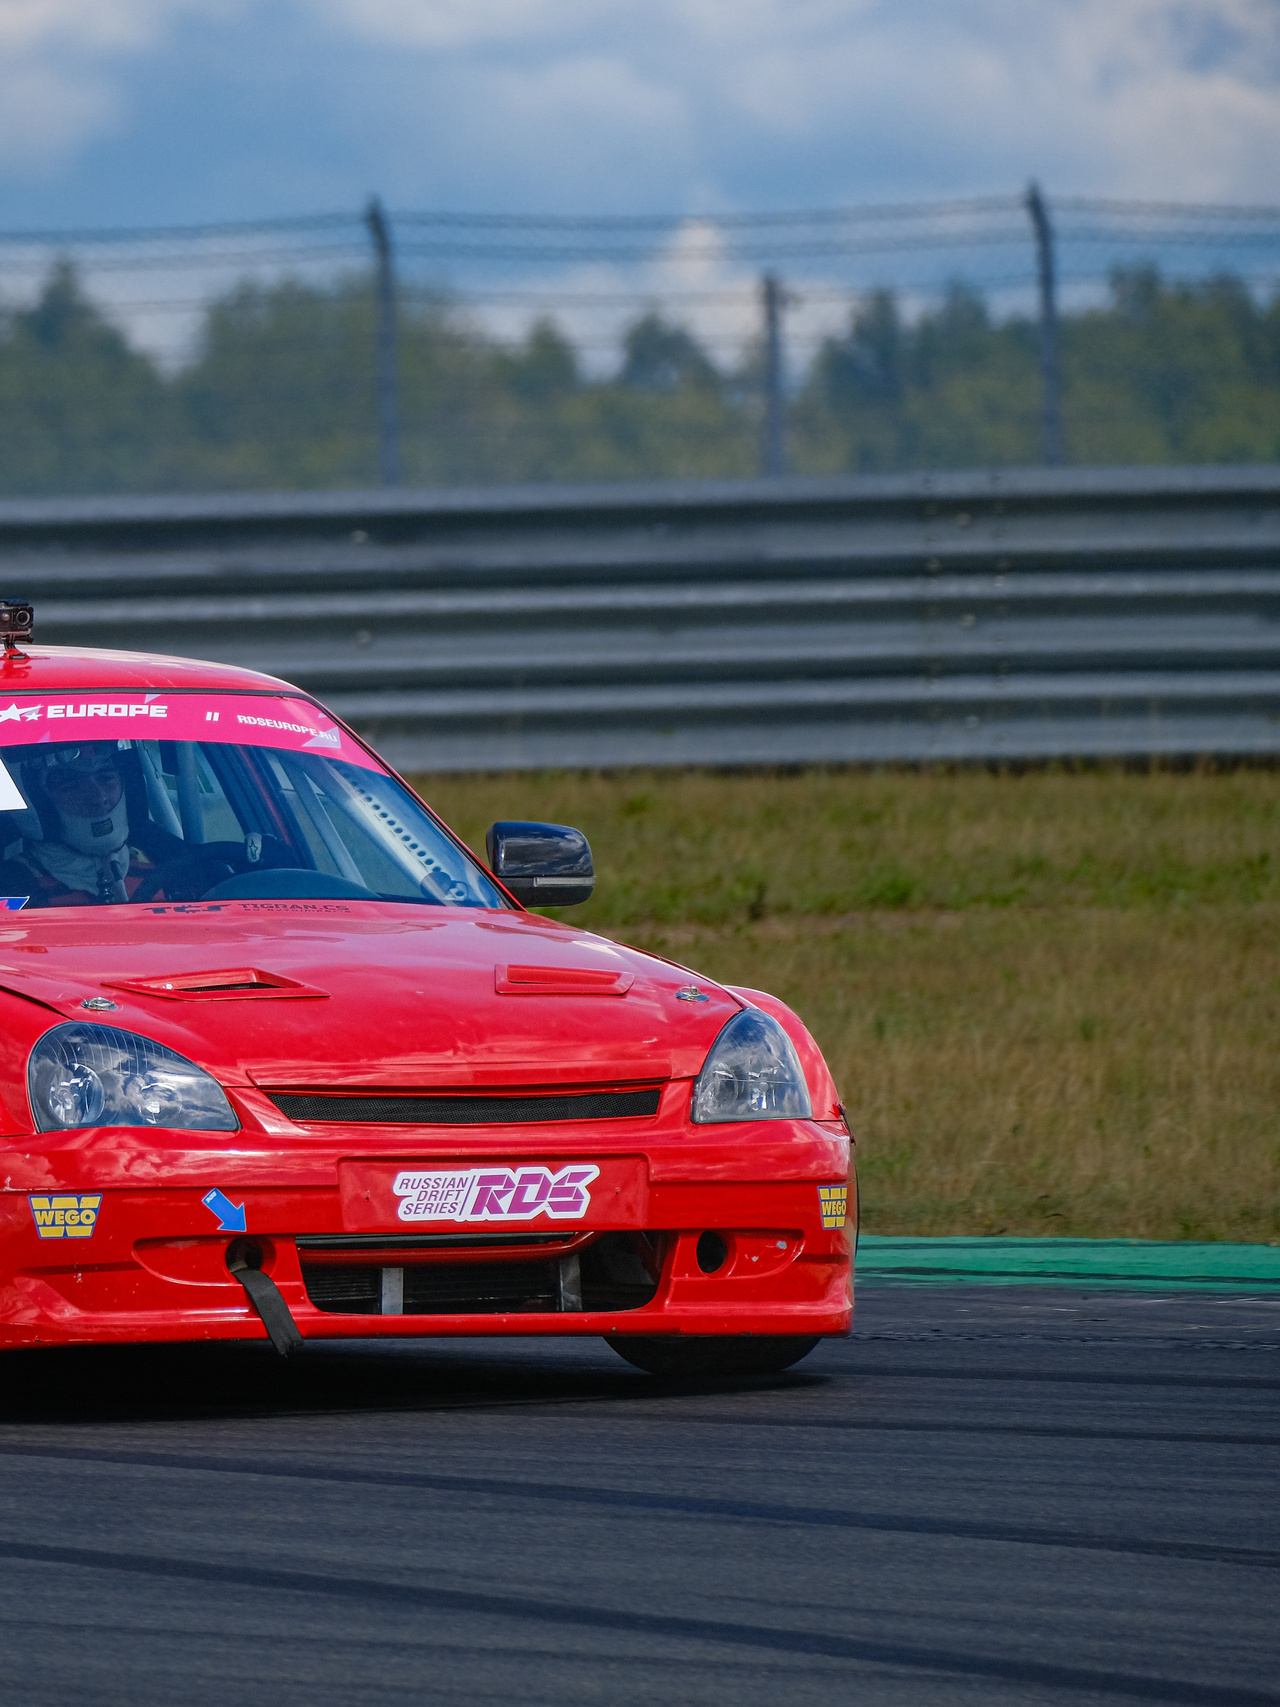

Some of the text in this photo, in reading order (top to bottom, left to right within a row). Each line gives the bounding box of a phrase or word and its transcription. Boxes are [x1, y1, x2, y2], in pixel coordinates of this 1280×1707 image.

[47, 704, 168, 718] EUROPE
[237, 715, 338, 742] RDSEUROPE.RU
[399, 1177, 468, 1190] RUSSIAN
[417, 1190, 464, 1202] DRIFT
[470, 1172, 594, 1215] RDS
[403, 1202, 459, 1215] SERIES
[821, 1200, 847, 1216] WEGO
[34, 1209, 96, 1225] WEGO
